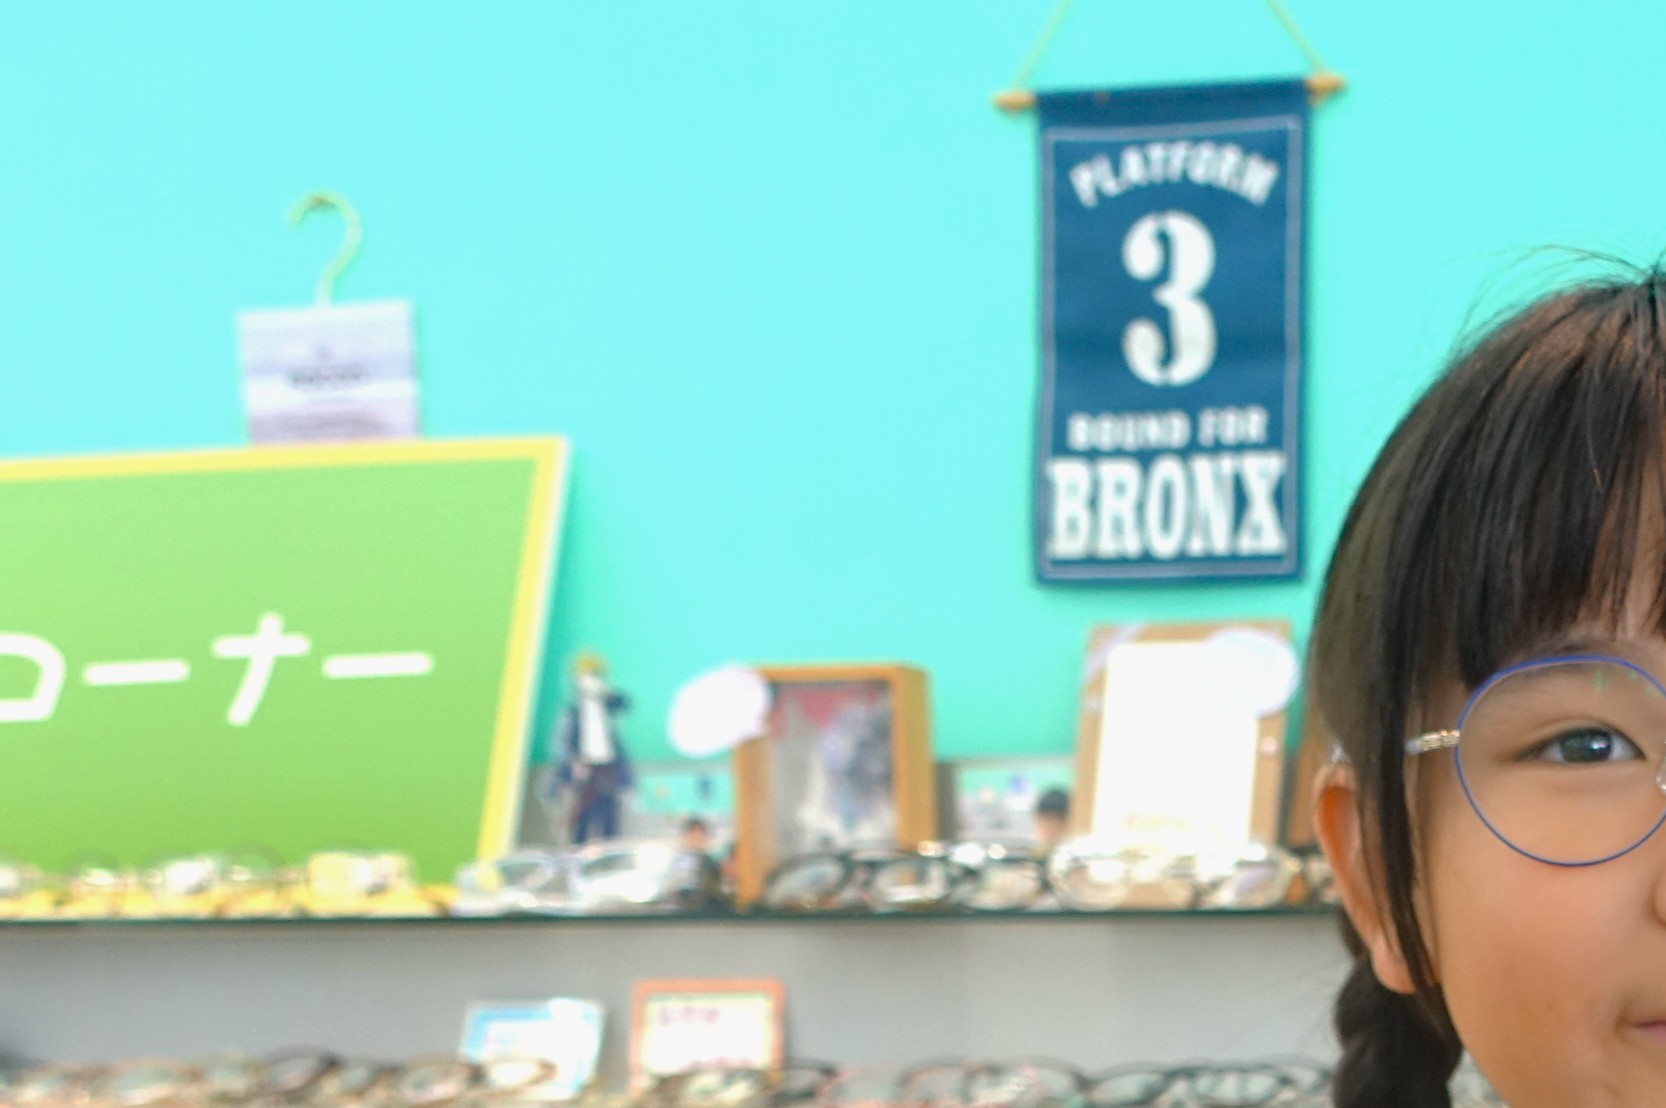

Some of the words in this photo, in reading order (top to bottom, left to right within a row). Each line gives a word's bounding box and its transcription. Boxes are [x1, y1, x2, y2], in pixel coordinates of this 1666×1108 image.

[1069, 142, 1279, 206] PLATFORM
[1122, 212, 1216, 385] 3
[1198, 405, 1268, 446] FOR
[1050, 453, 1285, 558] BRONX
